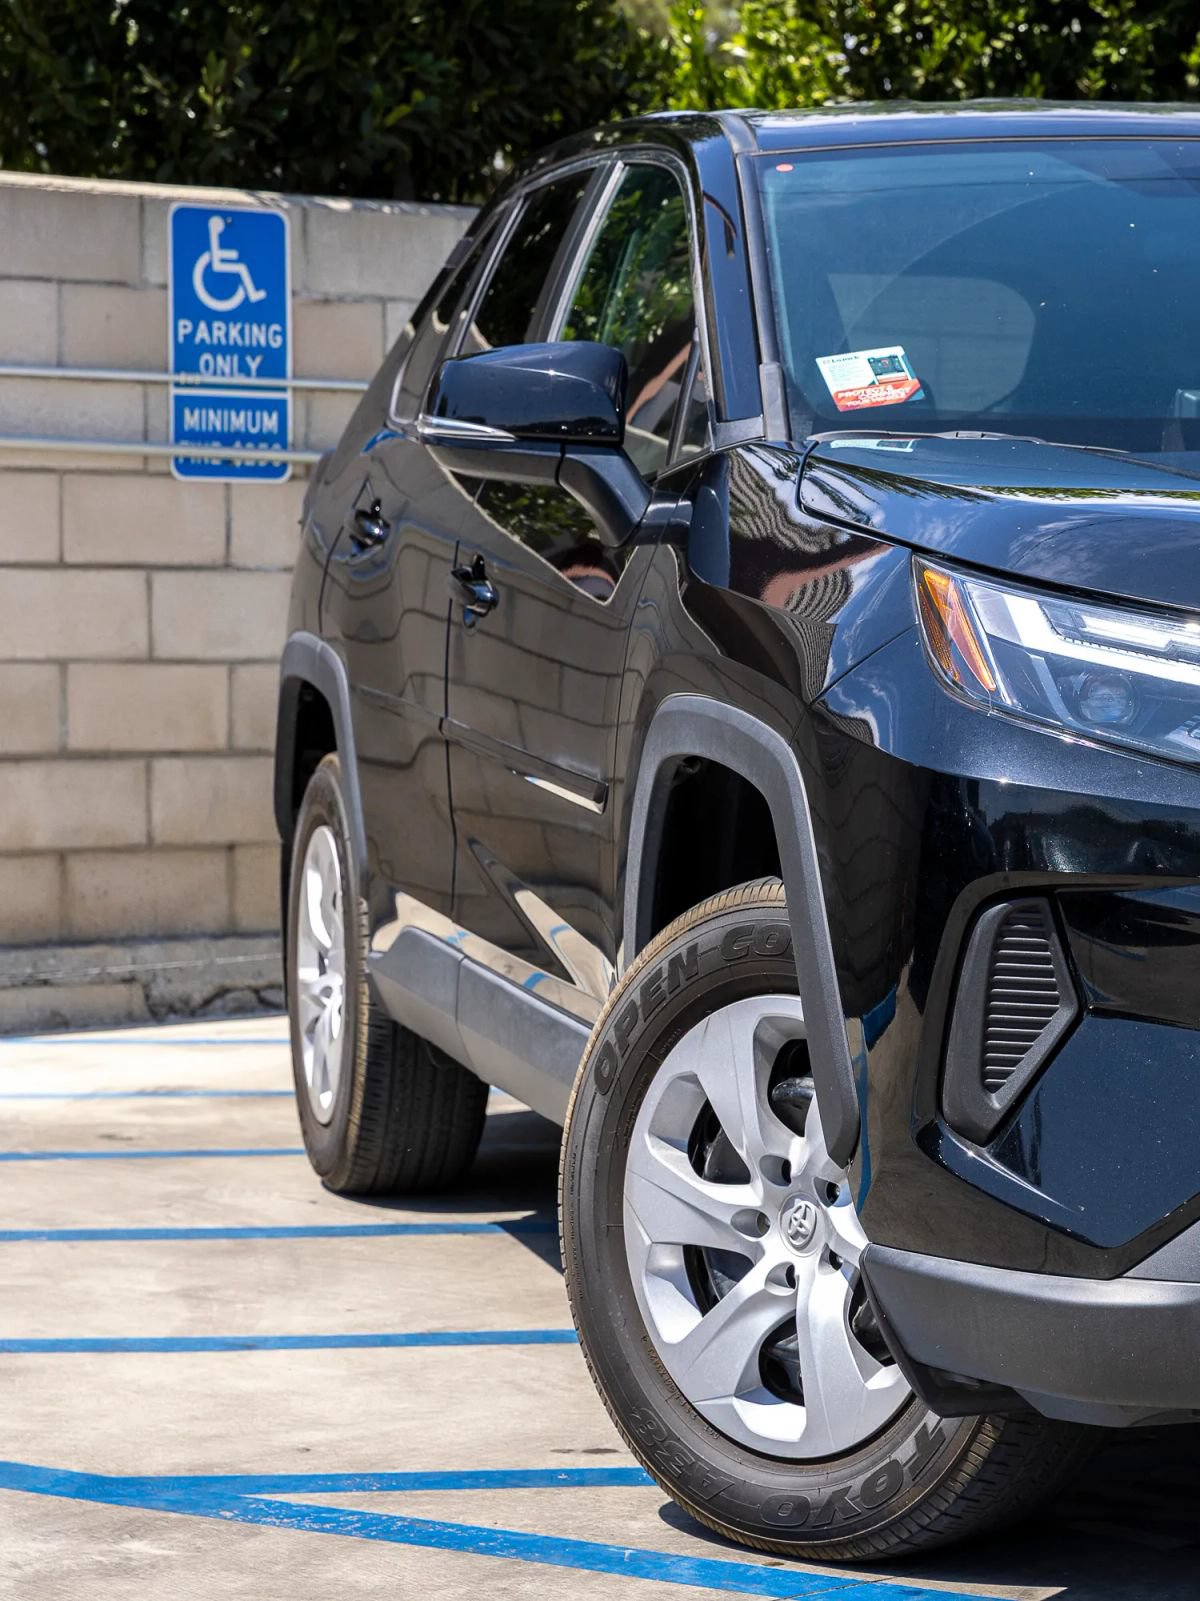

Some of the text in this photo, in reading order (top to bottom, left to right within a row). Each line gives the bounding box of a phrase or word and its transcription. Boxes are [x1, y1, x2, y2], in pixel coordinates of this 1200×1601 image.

[177, 319, 283, 348] PARKING
[199, 353, 263, 378] ONLY
[183, 407, 278, 434] MINIMUM
[594, 923, 792, 1096] OPEN CO
[759, 1421, 947, 1528] TOYO
